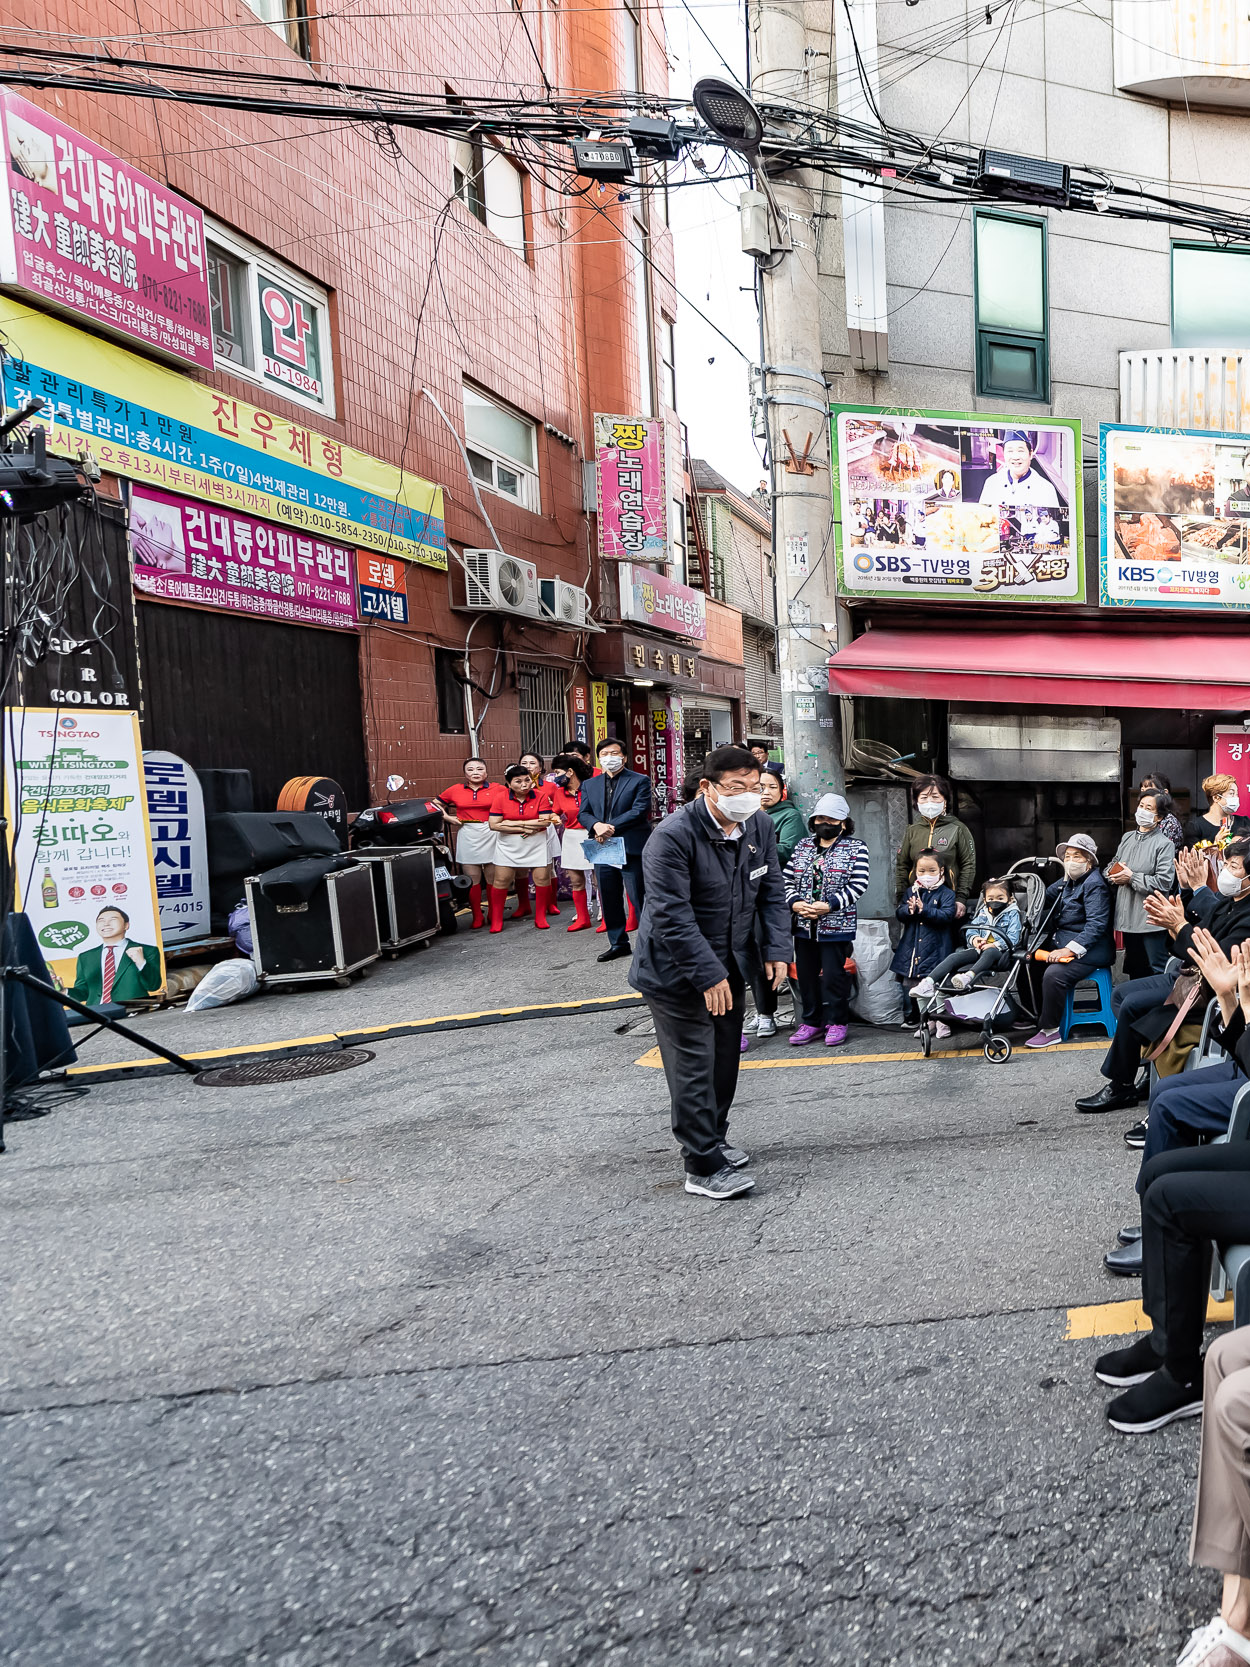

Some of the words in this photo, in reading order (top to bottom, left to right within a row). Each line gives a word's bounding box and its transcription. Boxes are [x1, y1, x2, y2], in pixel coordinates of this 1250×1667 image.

[55, 133, 205, 282] 건대동안피부관리
[261, 286, 312, 370] 압
[264, 357, 319, 395] 10-1984
[212, 394, 343, 477] 진우체형
[185, 506, 350, 585] 건대동안피부관리
[368, 560, 395, 589] 로뎀
[1118, 566, 1155, 582] KBS
[297, 582, 351, 606] 070-8221-7688
[363, 591, 405, 621] 고시텔
[642, 583, 701, 627] 짱노래연습장
[634, 644, 696, 678] 민수빌딩
[50, 688, 130, 706] COLOR
[38, 730, 100, 739] TSINGTAO
[28, 760, 59, 769] WITH
[61, 760, 116, 769] TSINGTAO
[77, 845, 131, 861] 갑니다!
